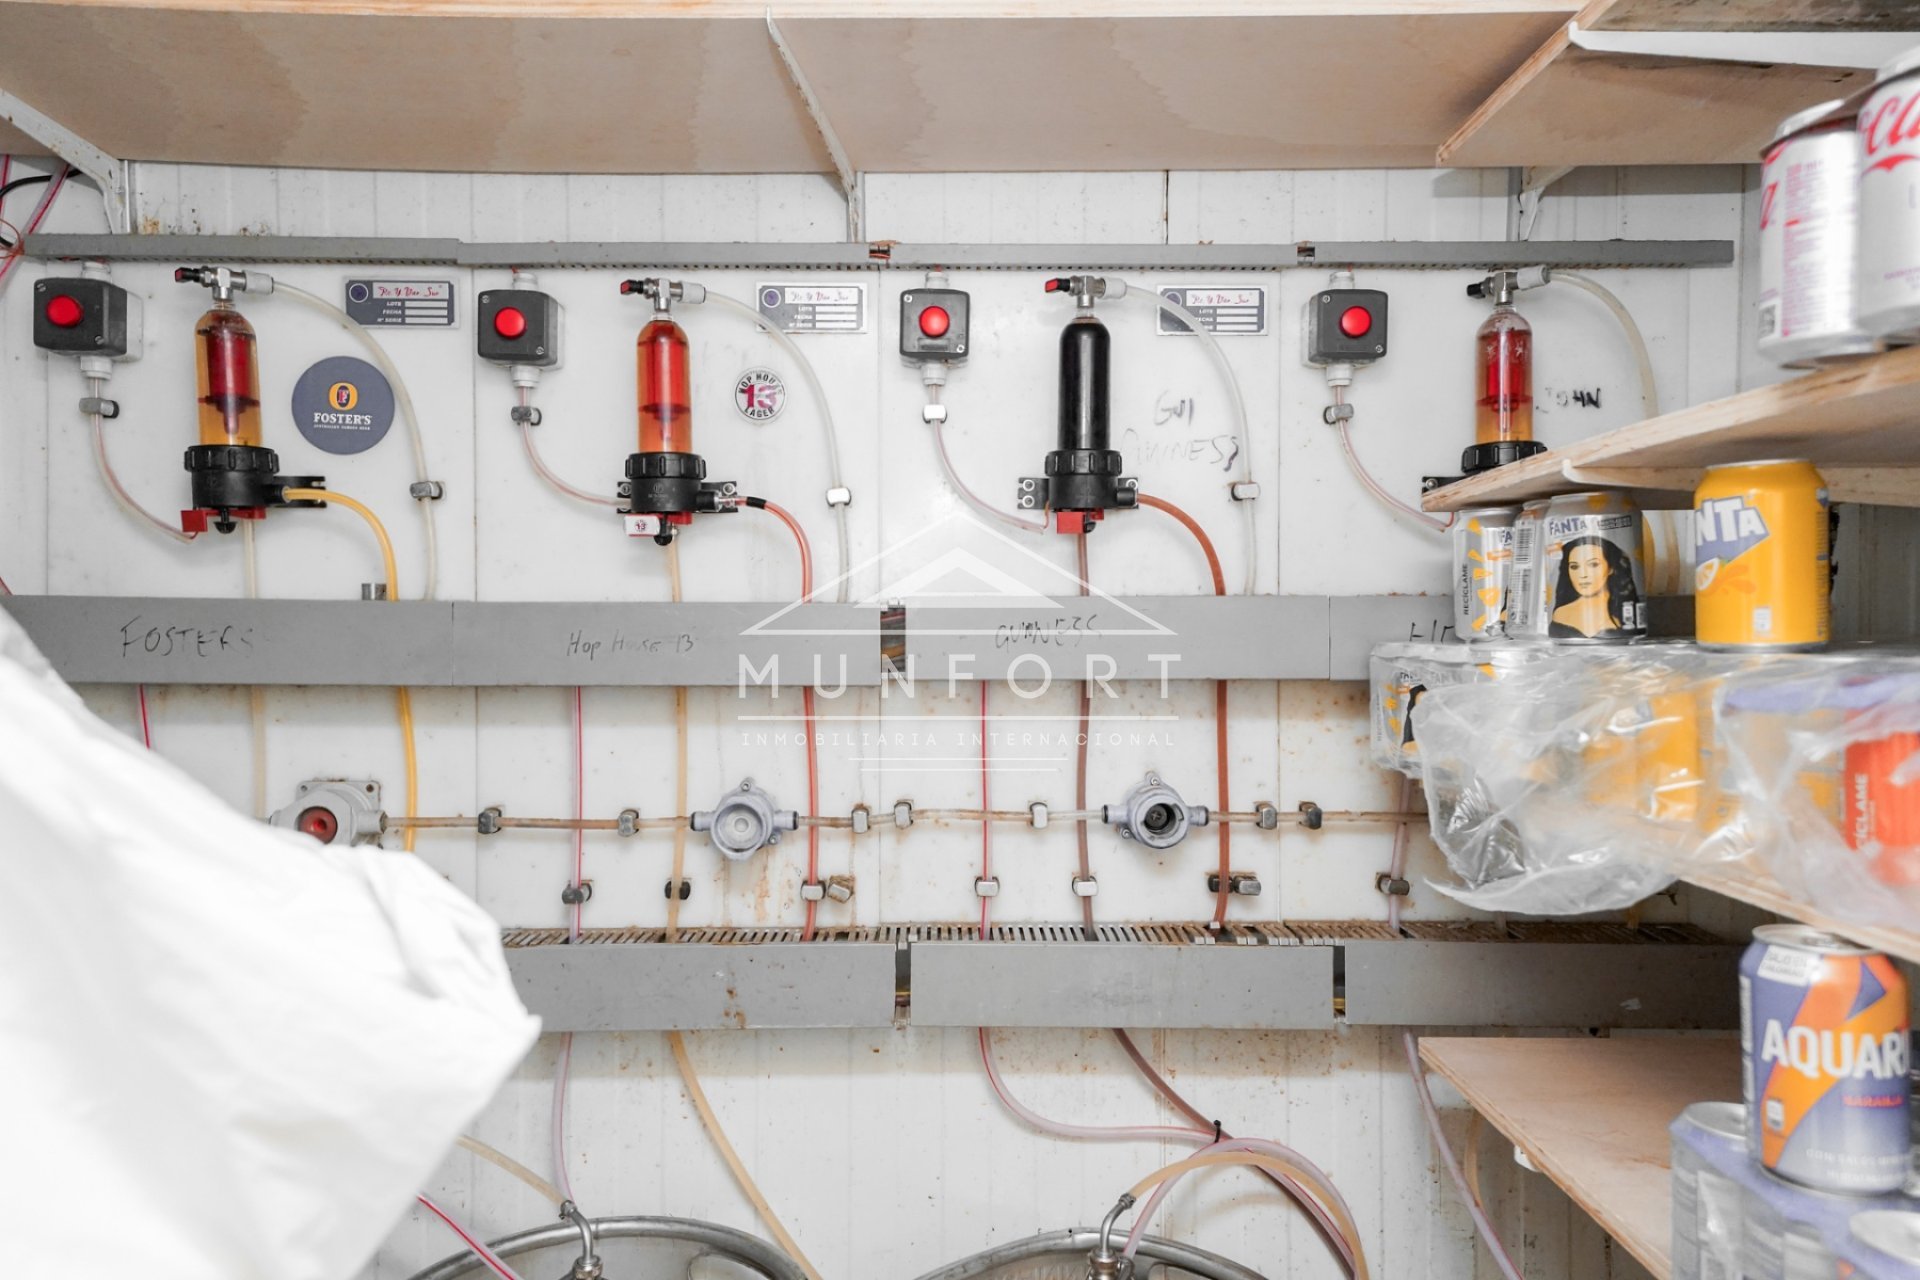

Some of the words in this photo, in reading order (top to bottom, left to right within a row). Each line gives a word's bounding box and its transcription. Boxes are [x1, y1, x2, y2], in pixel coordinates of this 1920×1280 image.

[745, 384, 777, 408] 13
[313, 412, 372, 425] FOSTER'S
[744, 406, 775, 418] LAGER
[1549, 517, 1588, 536] FANTA
[1462, 563, 1470, 616] RECICLAME
